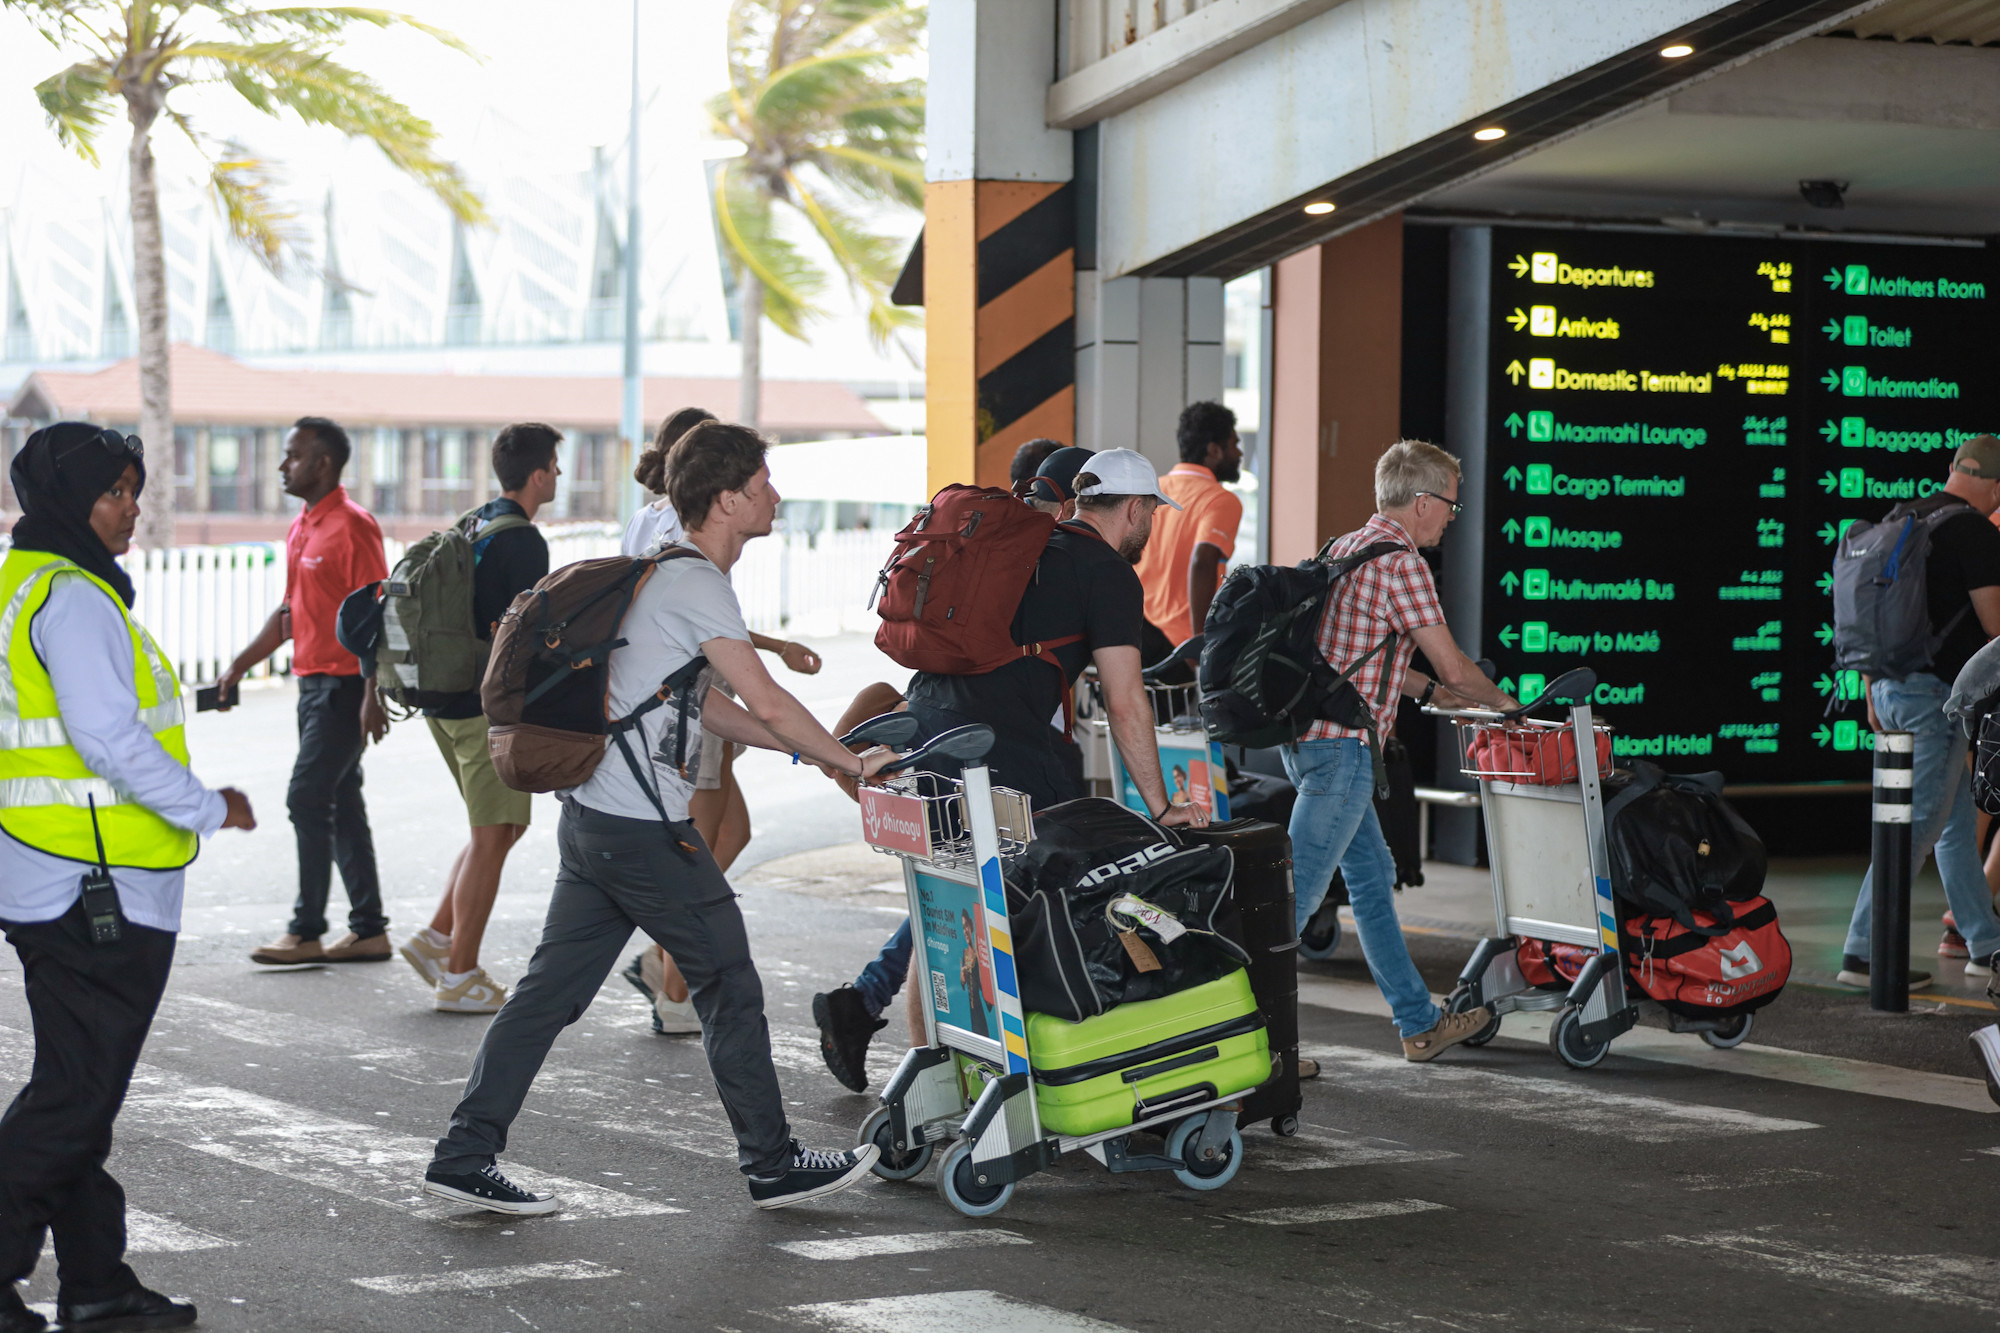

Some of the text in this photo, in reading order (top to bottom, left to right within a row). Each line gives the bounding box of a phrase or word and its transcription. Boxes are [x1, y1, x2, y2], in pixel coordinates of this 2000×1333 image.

[1558, 264, 1655, 290] Departures
[1870, 275, 1986, 300] Mothers Room
[1557, 317, 1621, 340] Arrivals
[1869, 325, 1912, 348] Toilet
[1555, 367, 1638, 393] Domestic
[1641, 370, 1713, 394] Terminal
[1867, 374, 1960, 399] Information
[1642, 424, 1708, 450] Lounge
[1865, 427, 1943, 453] Baggage
[1552, 473, 1685, 501] Cargo Terminal
[1865, 477, 1916, 499] Tourist
[1551, 527, 1623, 552] Mosque
[1646, 580, 1675, 601] Bus
[1548, 630, 1661, 656] Ferry to Malé
[1595, 682, 1646, 705] Court
[1612, 733, 1713, 756] Island Hotel
[882, 812, 922, 842] dhiraagu
[920, 888, 935, 903] No.1
[922, 903, 956, 923] Tourist SIM
[924, 918, 958, 940] in Maldives
[926, 936, 950, 955] dhiraagu
[1705, 969, 1777, 996] MOUNTAIN
